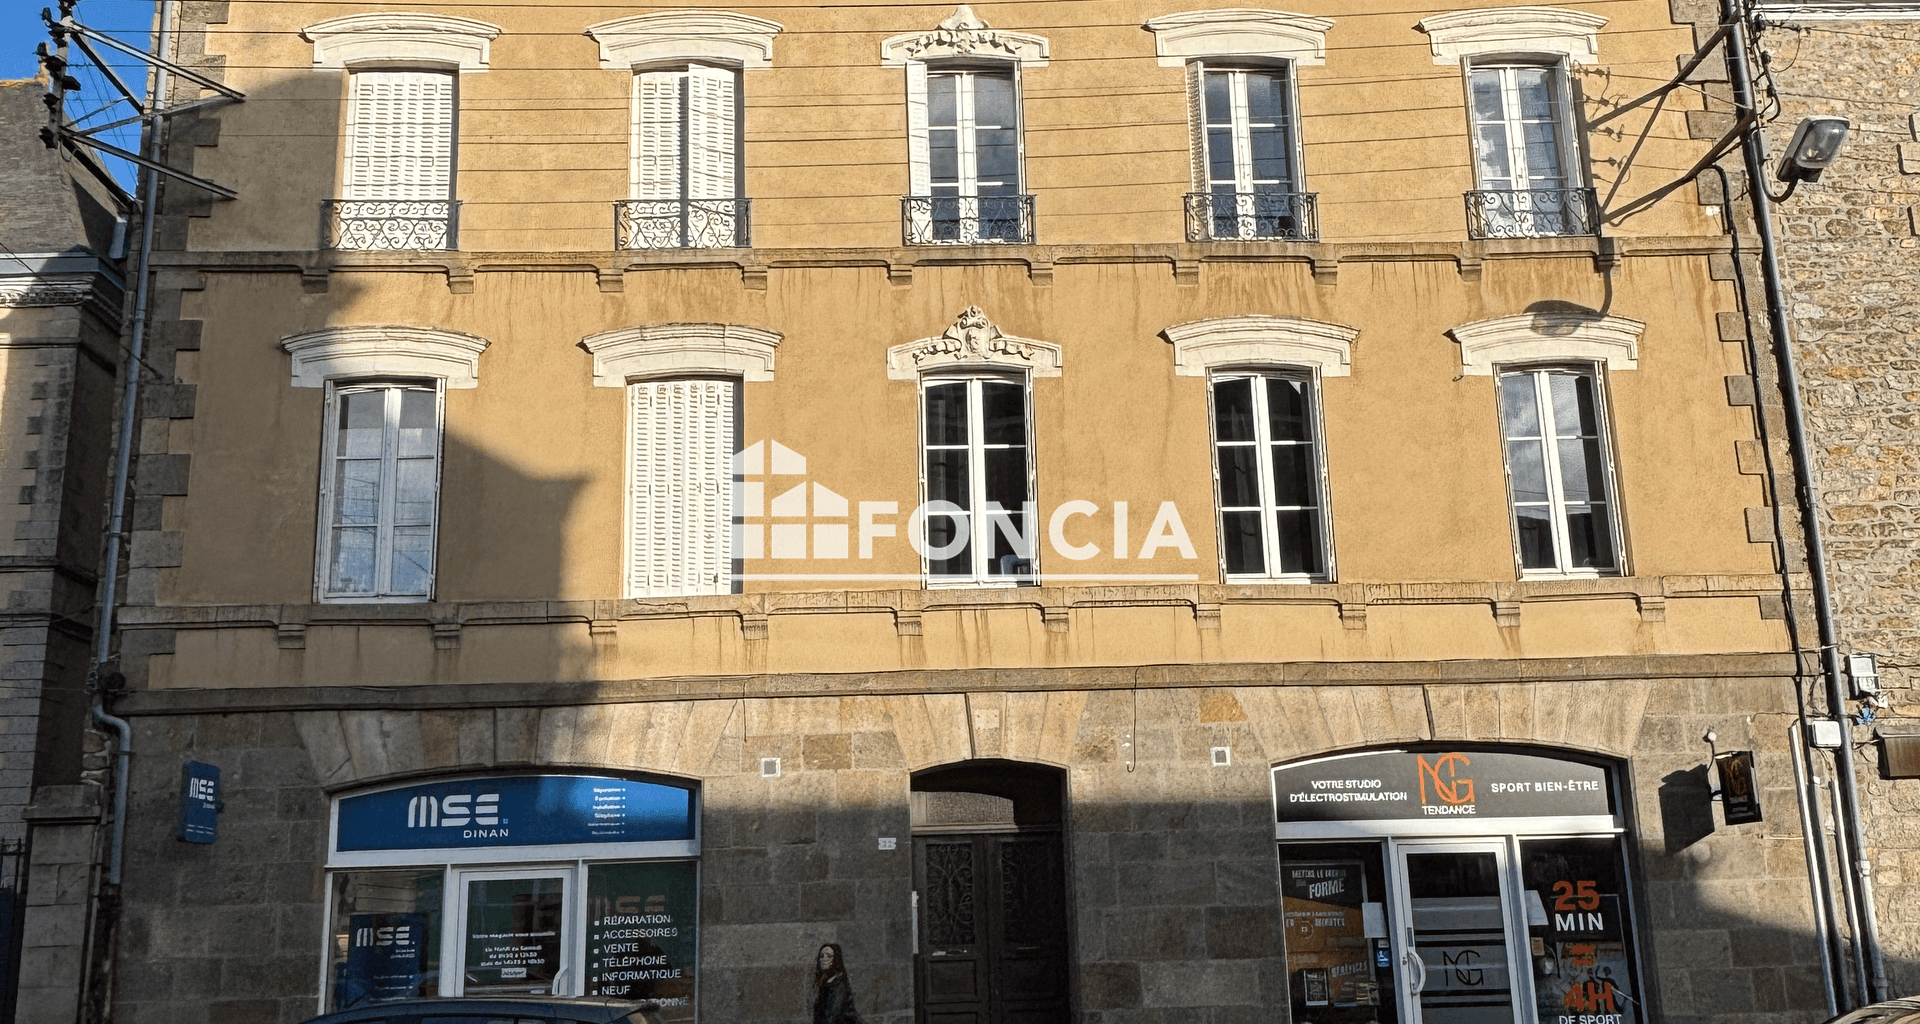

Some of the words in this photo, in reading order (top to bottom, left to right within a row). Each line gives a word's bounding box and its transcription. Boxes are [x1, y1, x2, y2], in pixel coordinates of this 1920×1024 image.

[1311, 780, 1344, 789] VOTRE
[1345, 779, 1381, 788] STUDIO
[1491, 782, 1532, 793] SPORT
[1534, 779, 1599, 792] BIEN-ÊTRE
[407, 793, 499, 828] MSE
[1422, 805, 1476, 815] TENDANCE
[463, 829, 509, 839] DINAN
[1309, 878, 1345, 899] FORME
[1552, 880, 1600, 911] 25
[604, 914, 671, 926] RÉPARATION
[1555, 912, 1604, 932] MIN
[356, 926, 410, 947] MSE
[603, 927, 678, 939] ACCESSOIRES
[603, 943, 639, 954] VENTE
[602, 955, 667, 968] TÉLÉPHONE
[602, 968, 682, 982] INFORMATIQUE
[601, 984, 631, 996] NEUF
[1564, 981, 1615, 1012] 4H
[1578, 1013, 1622, 1024] SPORT
